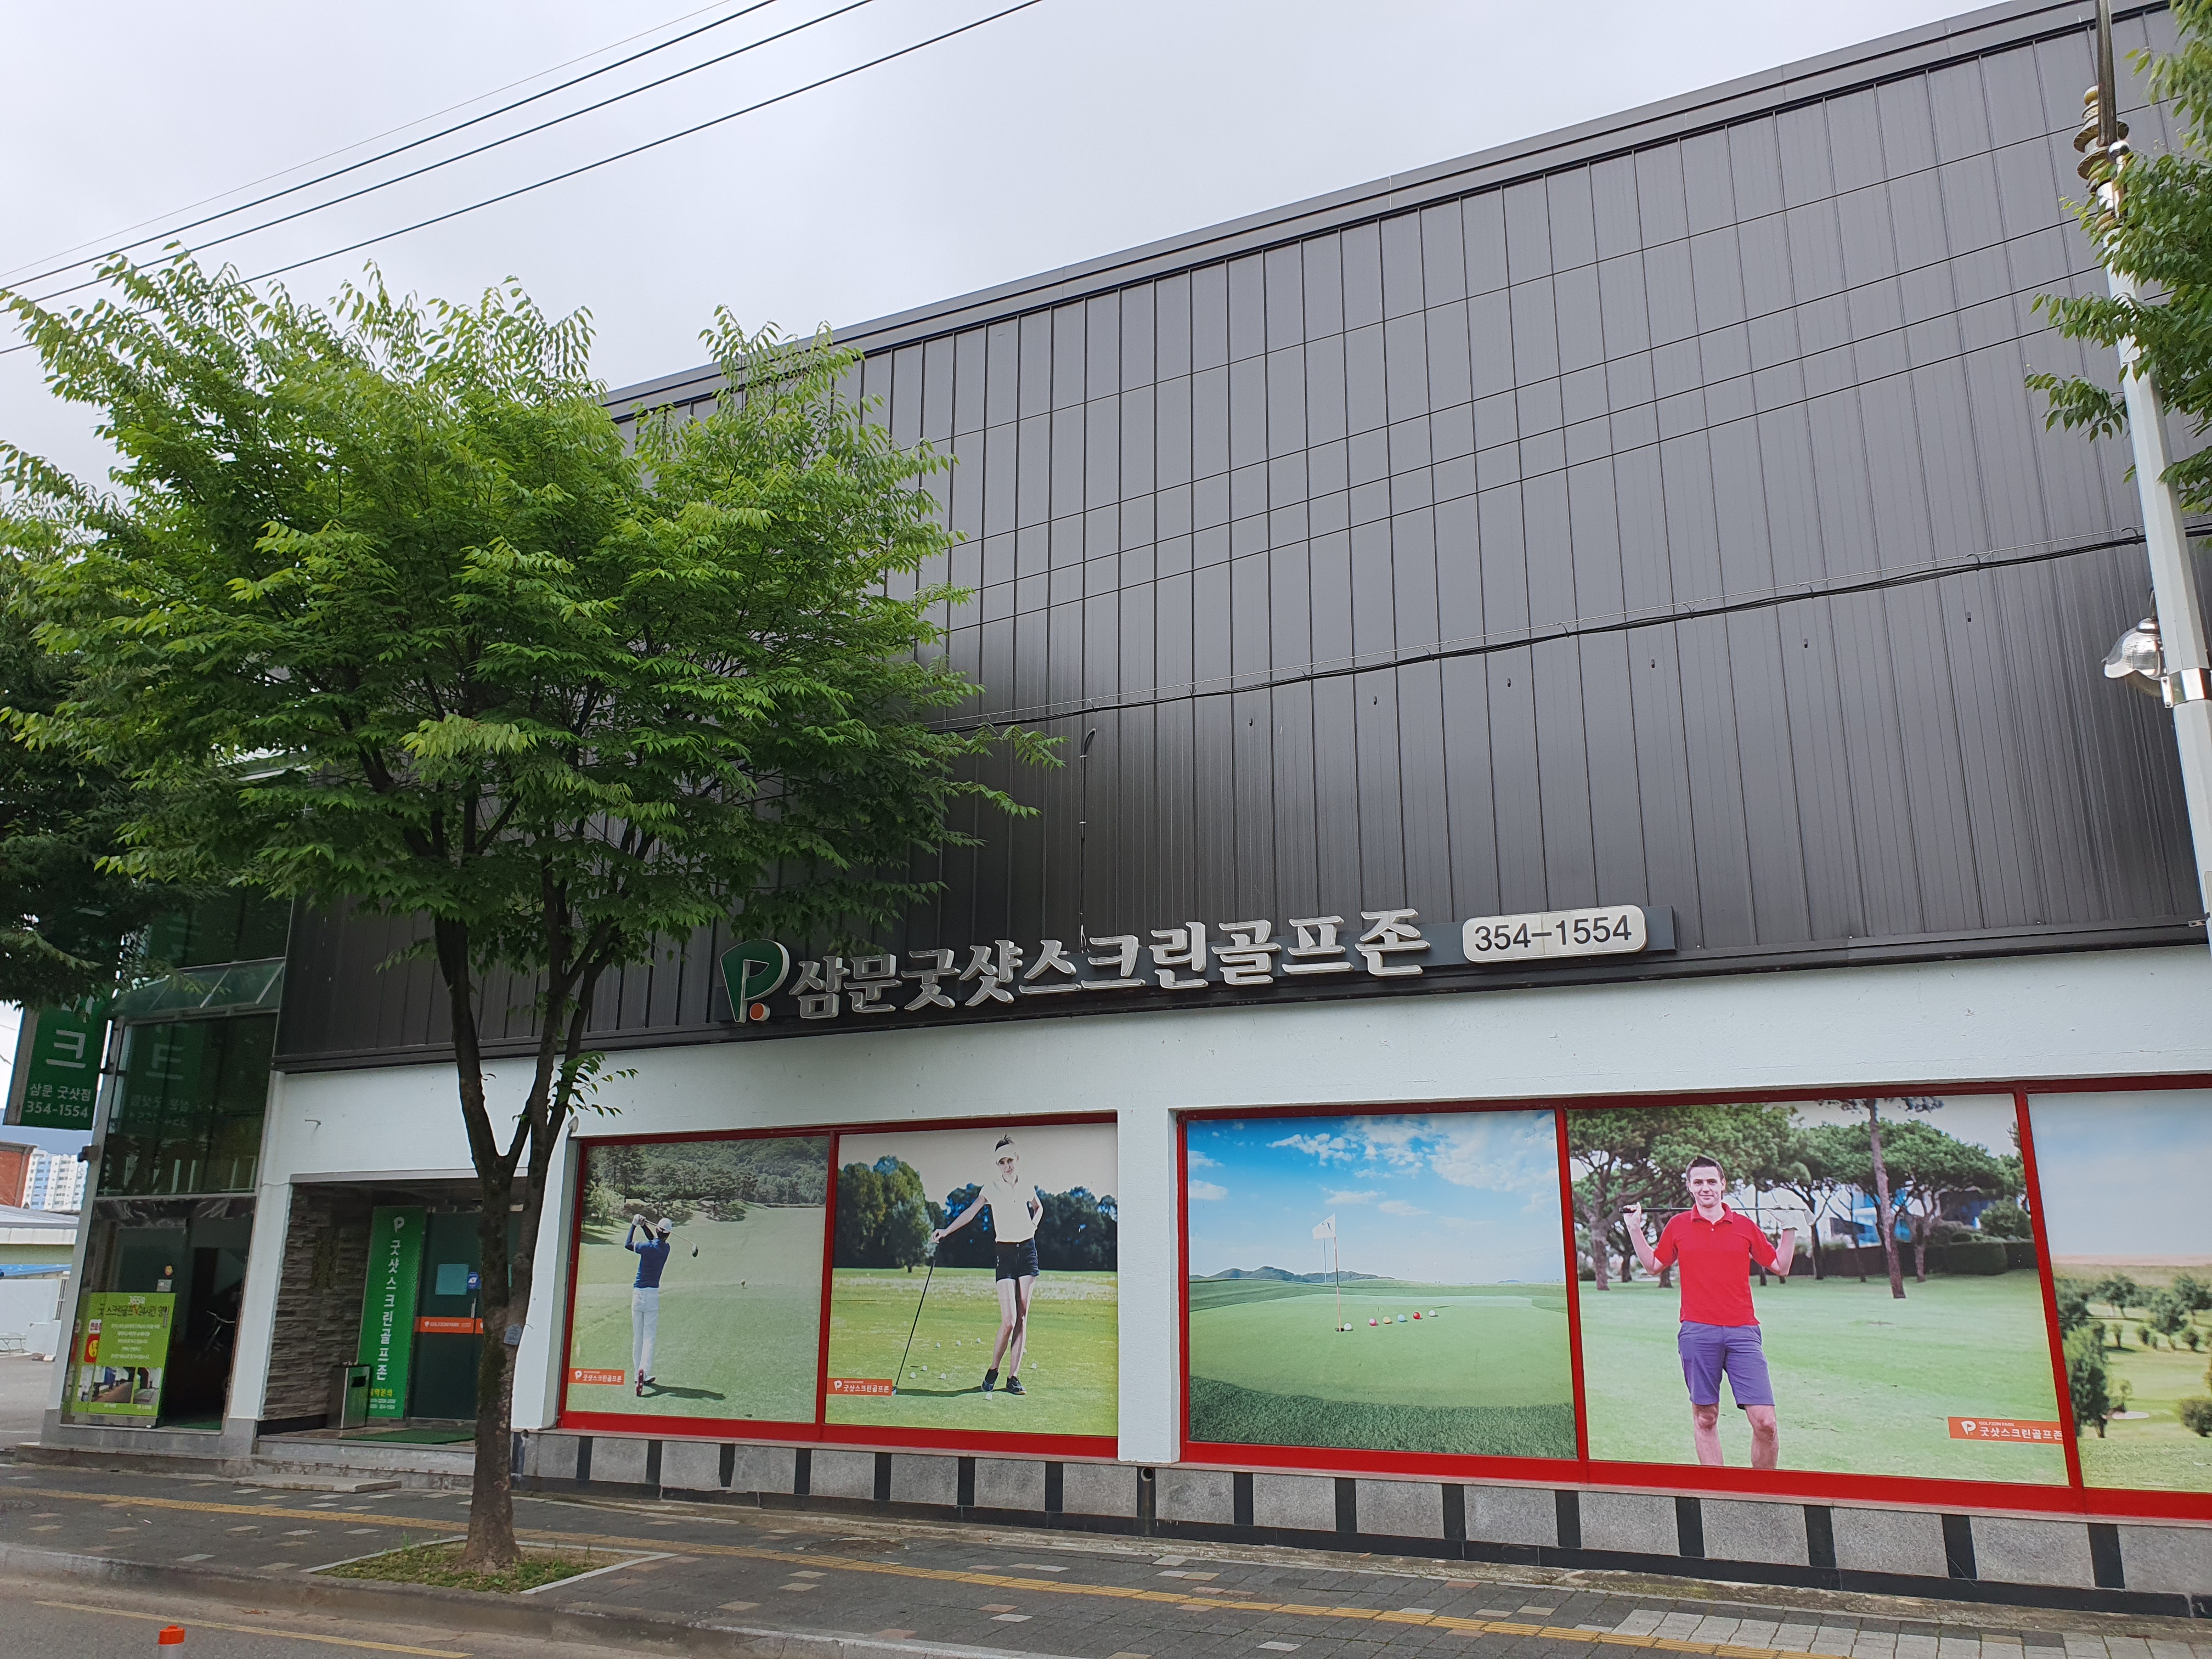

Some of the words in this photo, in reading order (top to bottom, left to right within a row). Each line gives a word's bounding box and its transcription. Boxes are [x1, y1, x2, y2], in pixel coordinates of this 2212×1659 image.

[1475, 915, 1632, 952] 354-1554
[789, 908, 1430, 1019] 삼문굿샷스크린골프존
[30, 1083, 53, 1097] 삼문
[58, 1086, 91, 1102] 굿샷점
[25, 1101, 89, 1118] 354-1554
[376, 1240, 401, 1381] 굿샷스크린골프존
[583, 1374, 622, 1383] 굿샷스크린골프존
[844, 1384, 889, 1393] 굿샷스크린골프존
[1979, 1426, 2063, 1441] 굿샷스크린골프존
